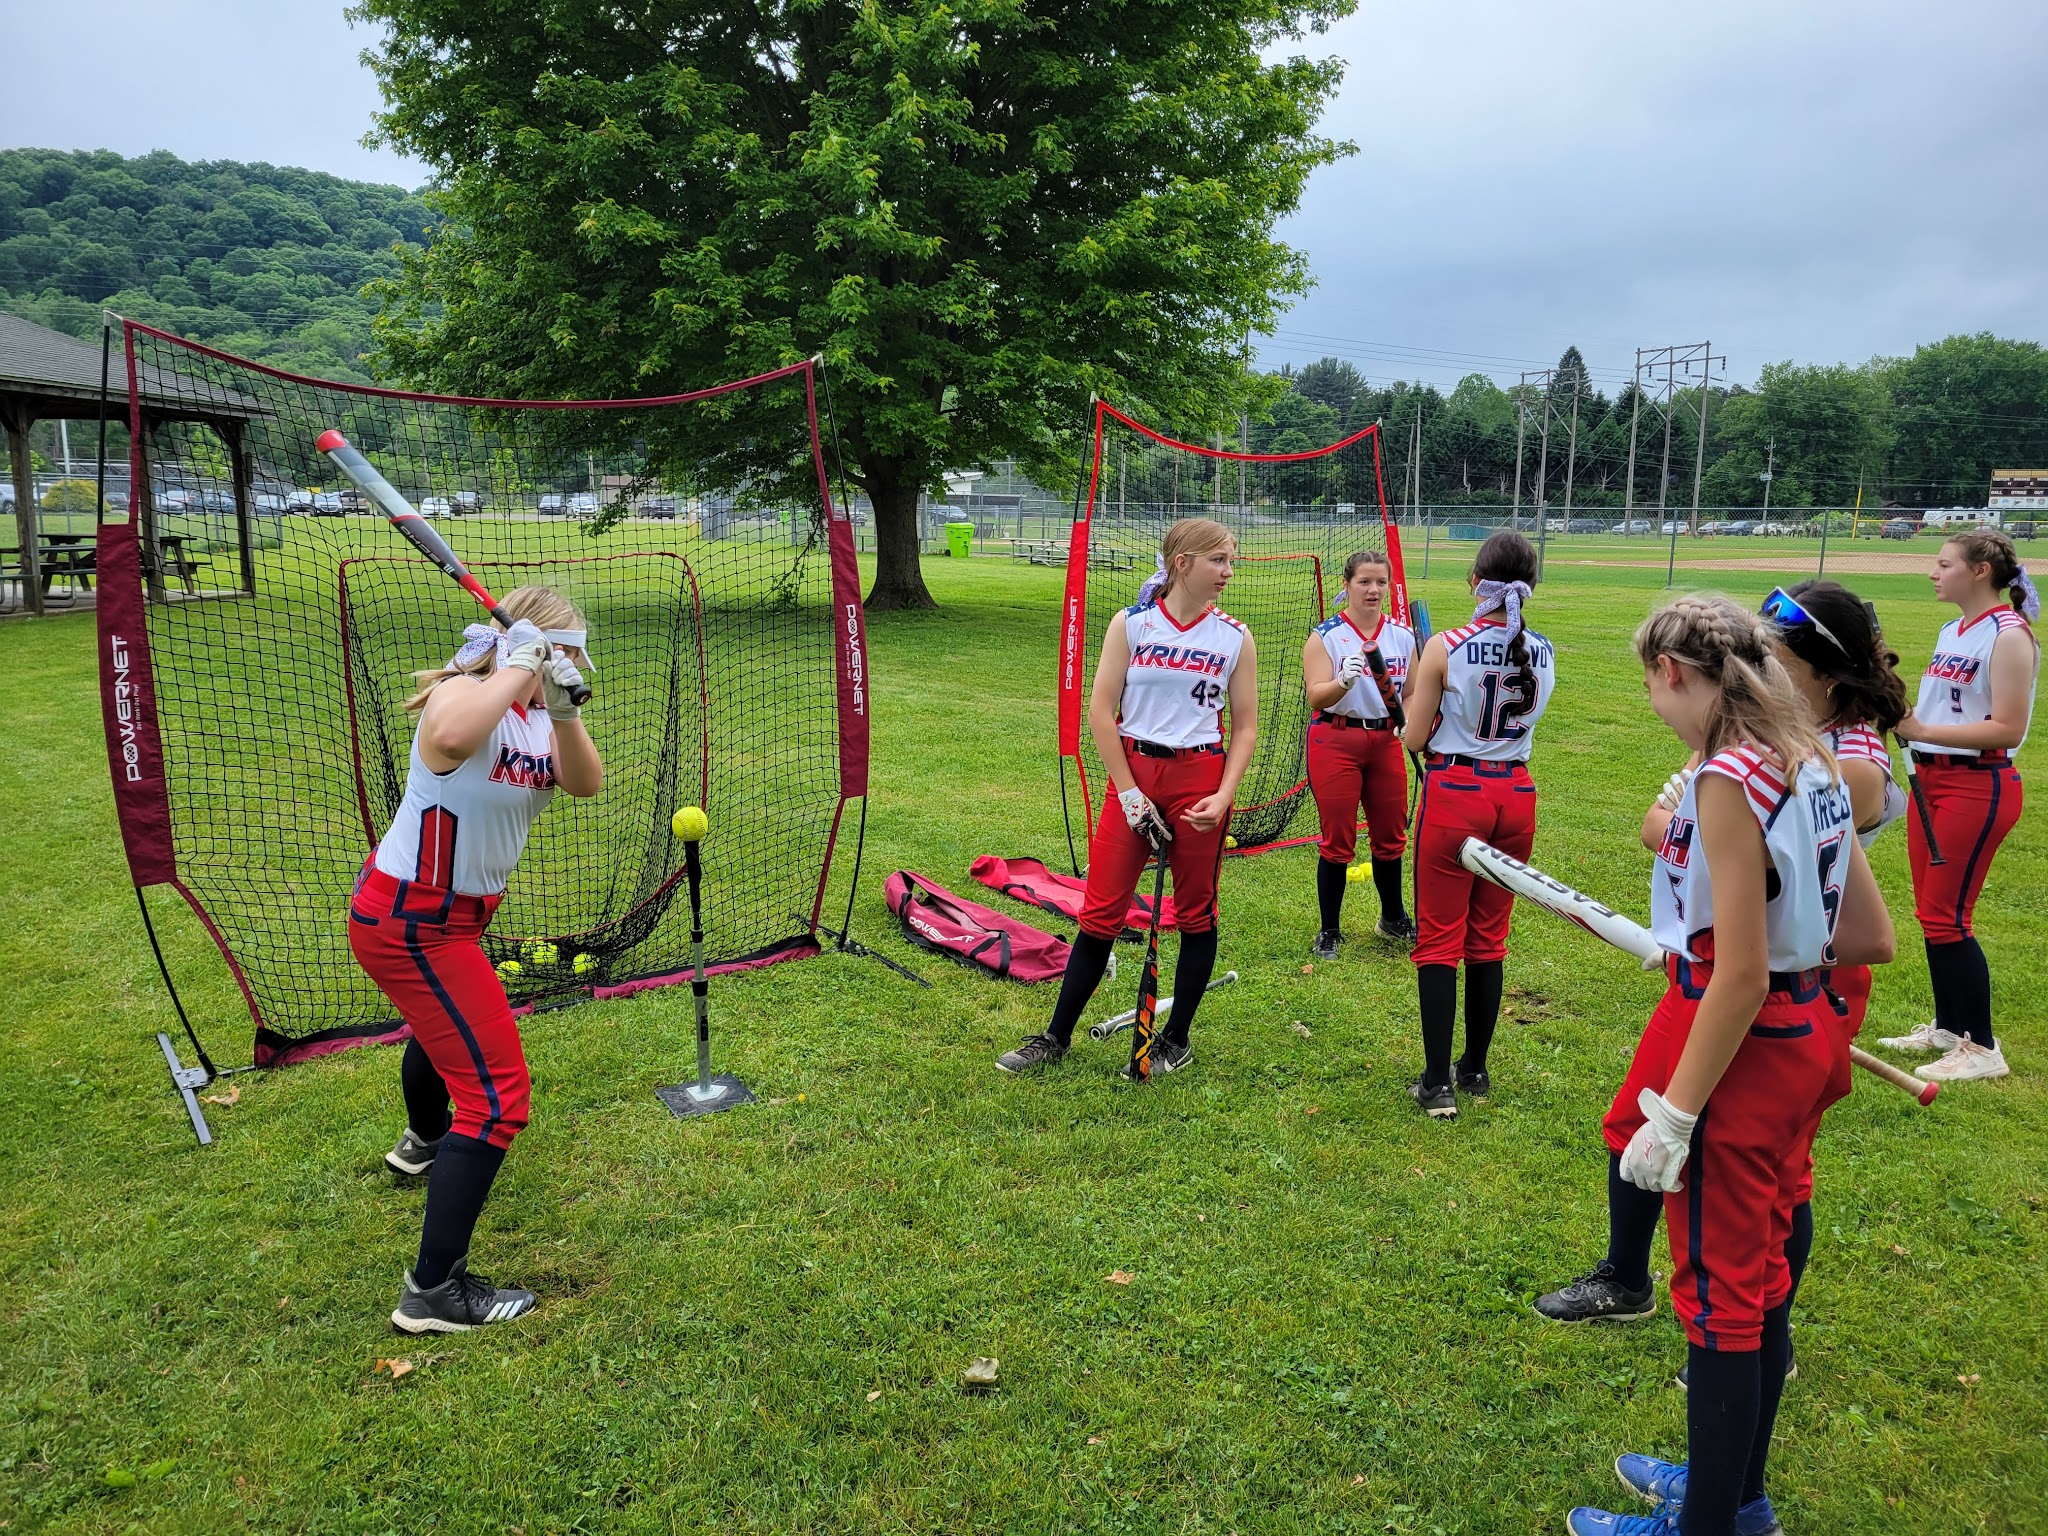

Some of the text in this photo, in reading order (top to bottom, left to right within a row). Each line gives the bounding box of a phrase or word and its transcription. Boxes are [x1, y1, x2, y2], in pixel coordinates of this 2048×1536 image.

[846, 604, 864, 716] POWERNET
[1065, 595, 1079, 690] POWERNET
[1130, 642, 1230, 679] KRUSH
[1466, 641, 1548, 669] DESAVO
[1922, 651, 1982, 686] RUSH
[111, 634, 142, 782] POWERNET
[1191, 679, 1221, 709] 42
[1475, 670, 1539, 742] 12
[1950, 687, 1963, 714] 9
[487, 743, 555, 791] KRUS
[1478, 844, 1619, 919] EASTON
